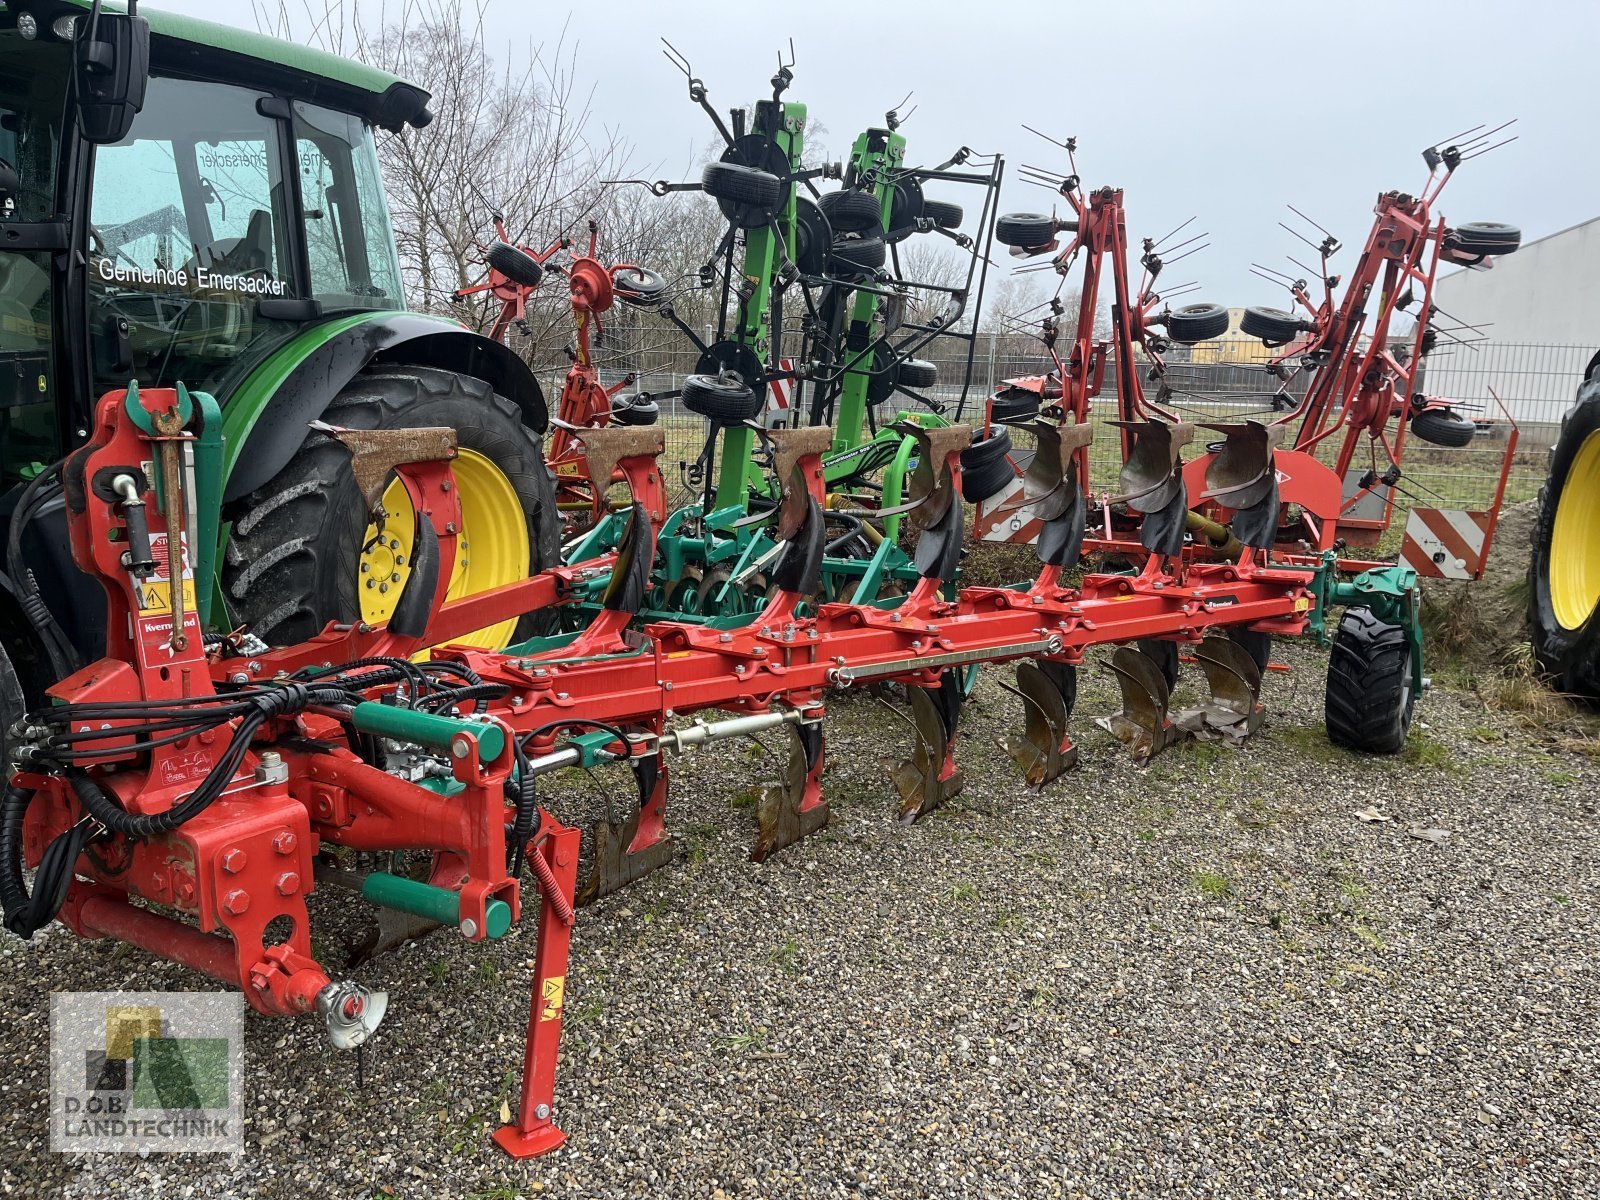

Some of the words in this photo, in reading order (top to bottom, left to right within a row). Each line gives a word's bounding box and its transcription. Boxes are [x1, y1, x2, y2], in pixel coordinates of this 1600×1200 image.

[99, 258, 188, 287] Gemeinde
[197, 267, 287, 296] Emersacker
[145, 617, 196, 633] Kvernnd
